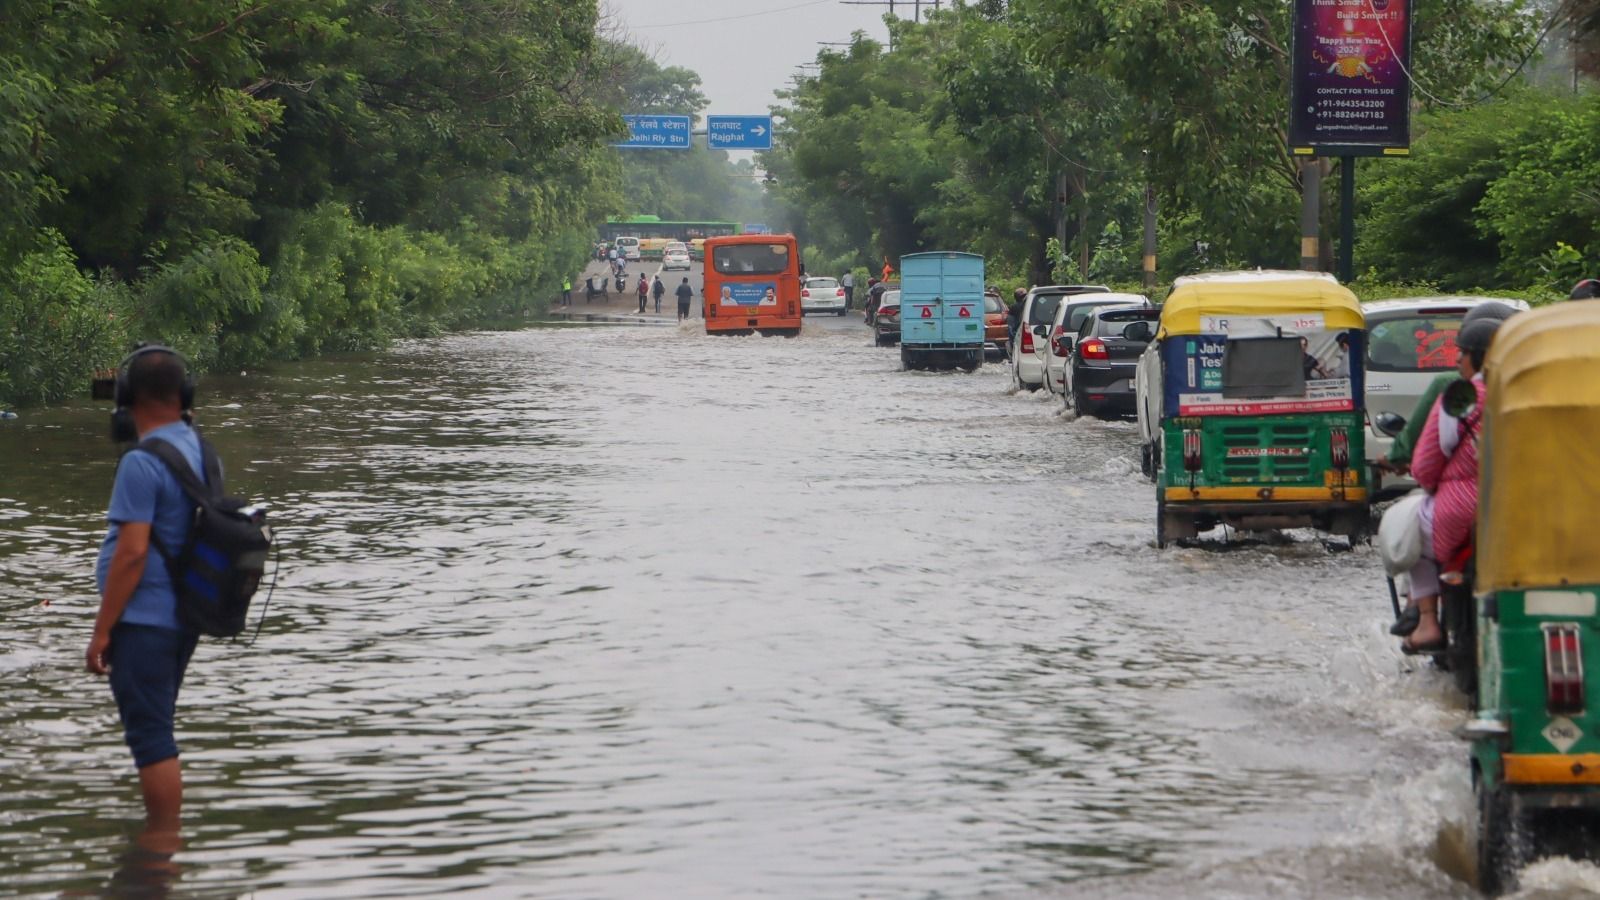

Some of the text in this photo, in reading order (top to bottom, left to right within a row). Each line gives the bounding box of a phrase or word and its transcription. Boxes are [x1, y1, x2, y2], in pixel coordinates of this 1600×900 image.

[1337, 11, 1359, 19] Build
[1361, 11, 1388, 19] Smart
[1338, 46, 1361, 54] 2024
[663, 119, 686, 129] स्टेशन
[711, 122, 742, 131] राजघाट
[652, 134, 666, 144] Rly
[670, 134, 684, 143] Stn
[711, 132, 745, 143] Rajghat
[1550, 727, 1575, 739] CNG
